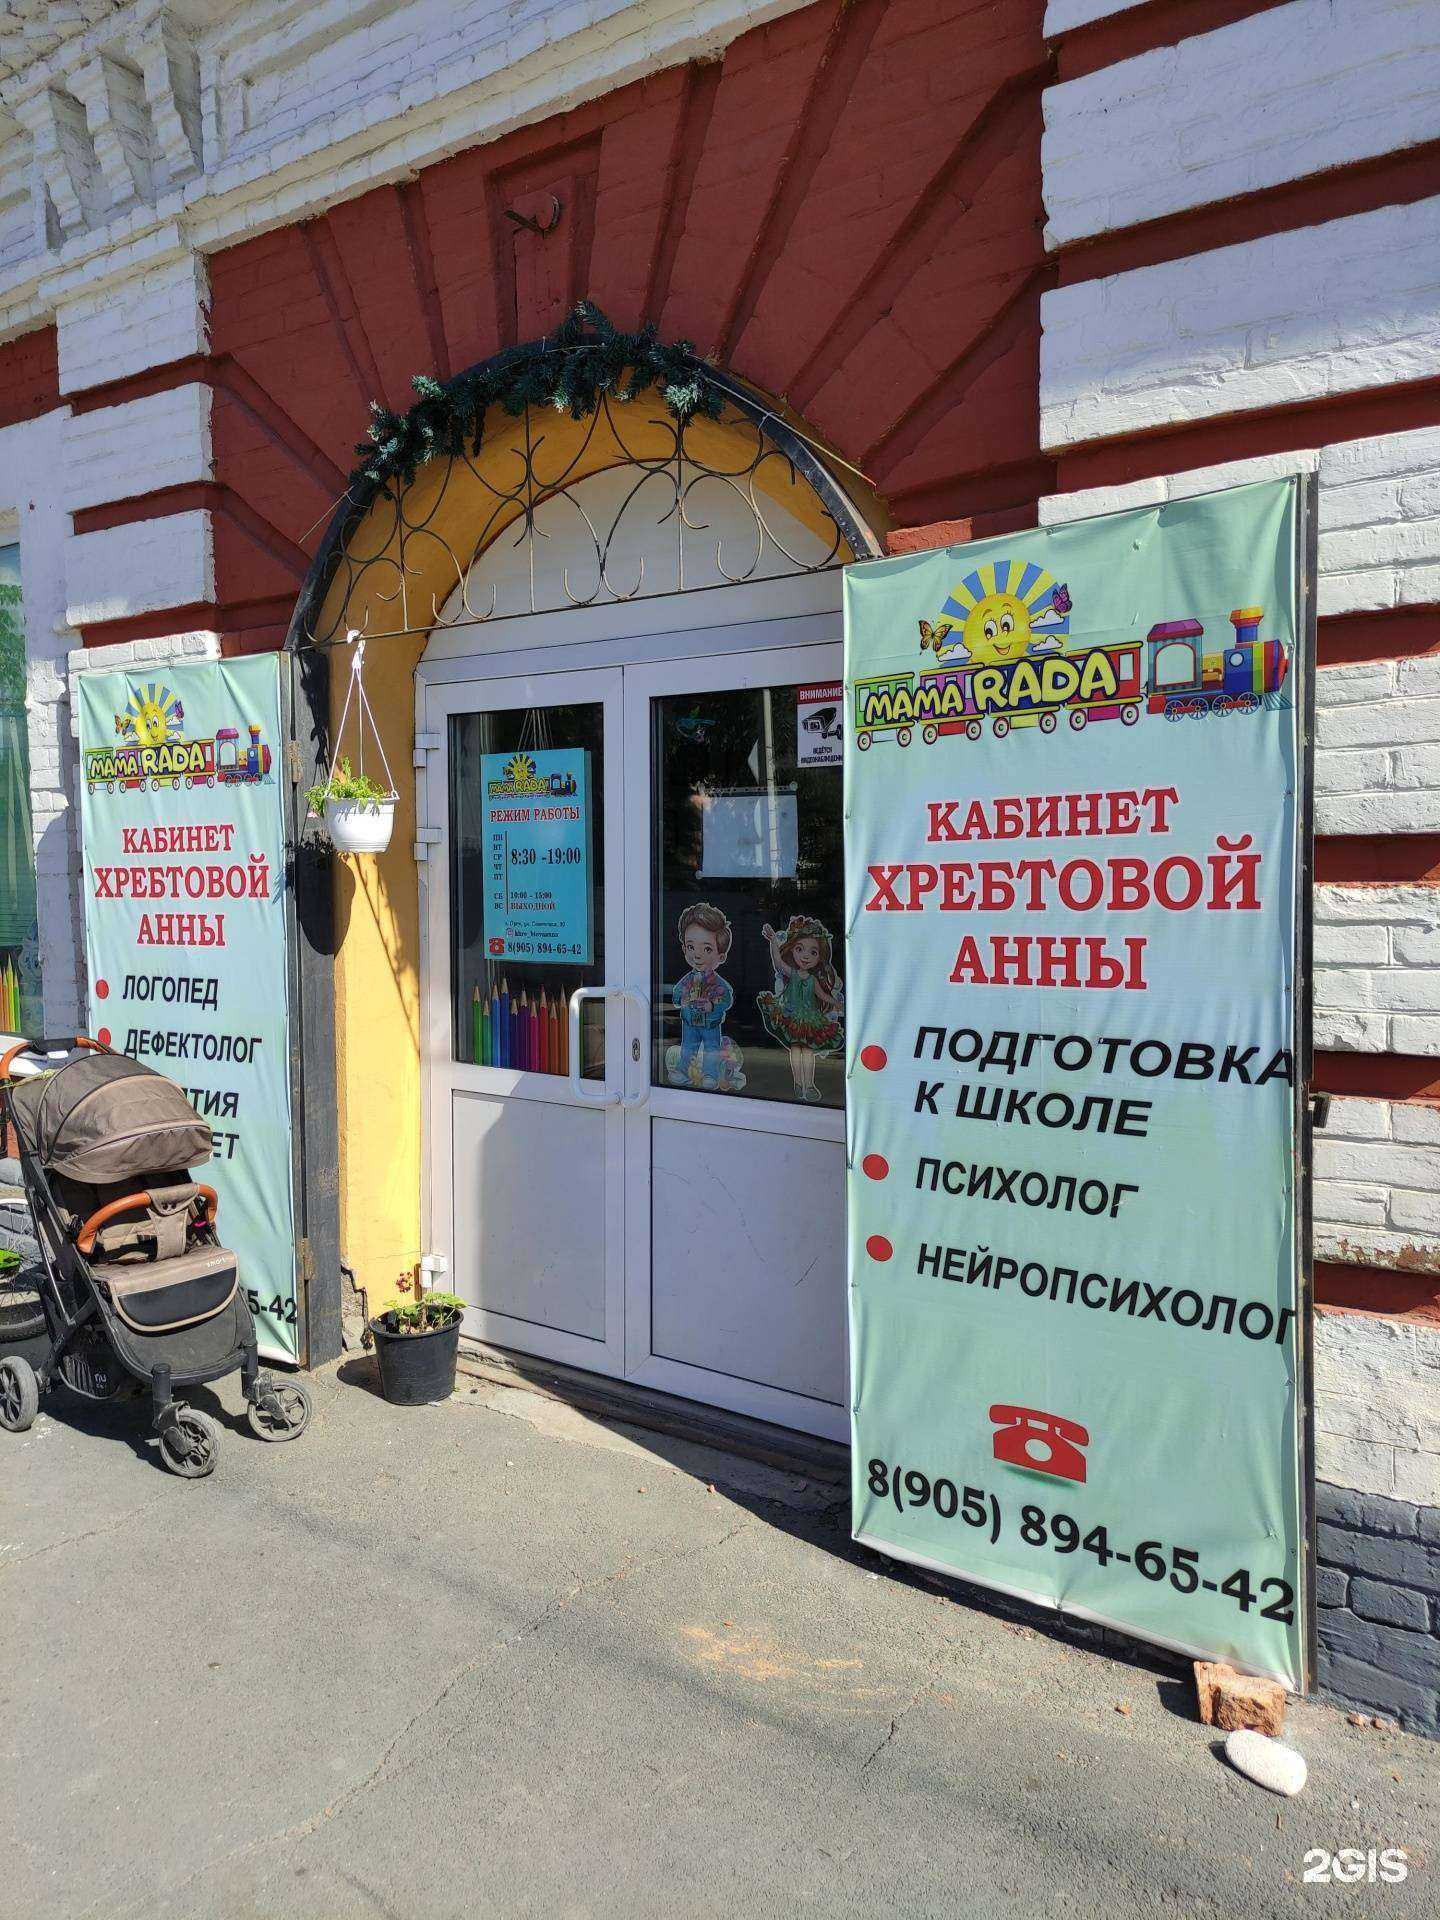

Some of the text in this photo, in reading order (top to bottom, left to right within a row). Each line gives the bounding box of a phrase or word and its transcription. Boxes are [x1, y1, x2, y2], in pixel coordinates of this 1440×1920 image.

[800, 687, 842, 700] ВНИМАНИЕ
[974, 651, 1118, 708] RADA
[141, 743, 206, 776] RADA
[490, 806, 580, 822] РЕЖИМ РАБОТЫ
[926, 787, 1179, 843] КАБИНЕТ
[122, 823, 235, 854] КАБИНЕТ
[511, 848, 536, 865] 8:30
[94, 853, 271, 899] ХРЕБТОВОЙ
[865, 834, 1263, 912] ХРЕБТОВОЙ
[136, 913, 226, 947] АННЫ
[507, 942, 582, 955] 8(905) 894-65-42
[949, 935, 1147, 991] АННЫ
[122, 975, 219, 1011] ЛОГОПЕД
[124, 1028, 263, 1064] ДЕФЕКТОЛОГ
[913, 1026, 1295, 1088] ПОДГОТОВКА
[181, 1087, 240, 1119] ТИЯ
[914, 1080, 1154, 1138] К ШКОЛЕ
[915, 1156, 1140, 1219] ПСИХОЛОГ
[240, 1286, 297, 1326] 5-42
[916, 1242, 1297, 1346] НЕЙРОПСИХОЛОГ
[867, 1458, 1296, 1627] 8(905) 894-65-42
